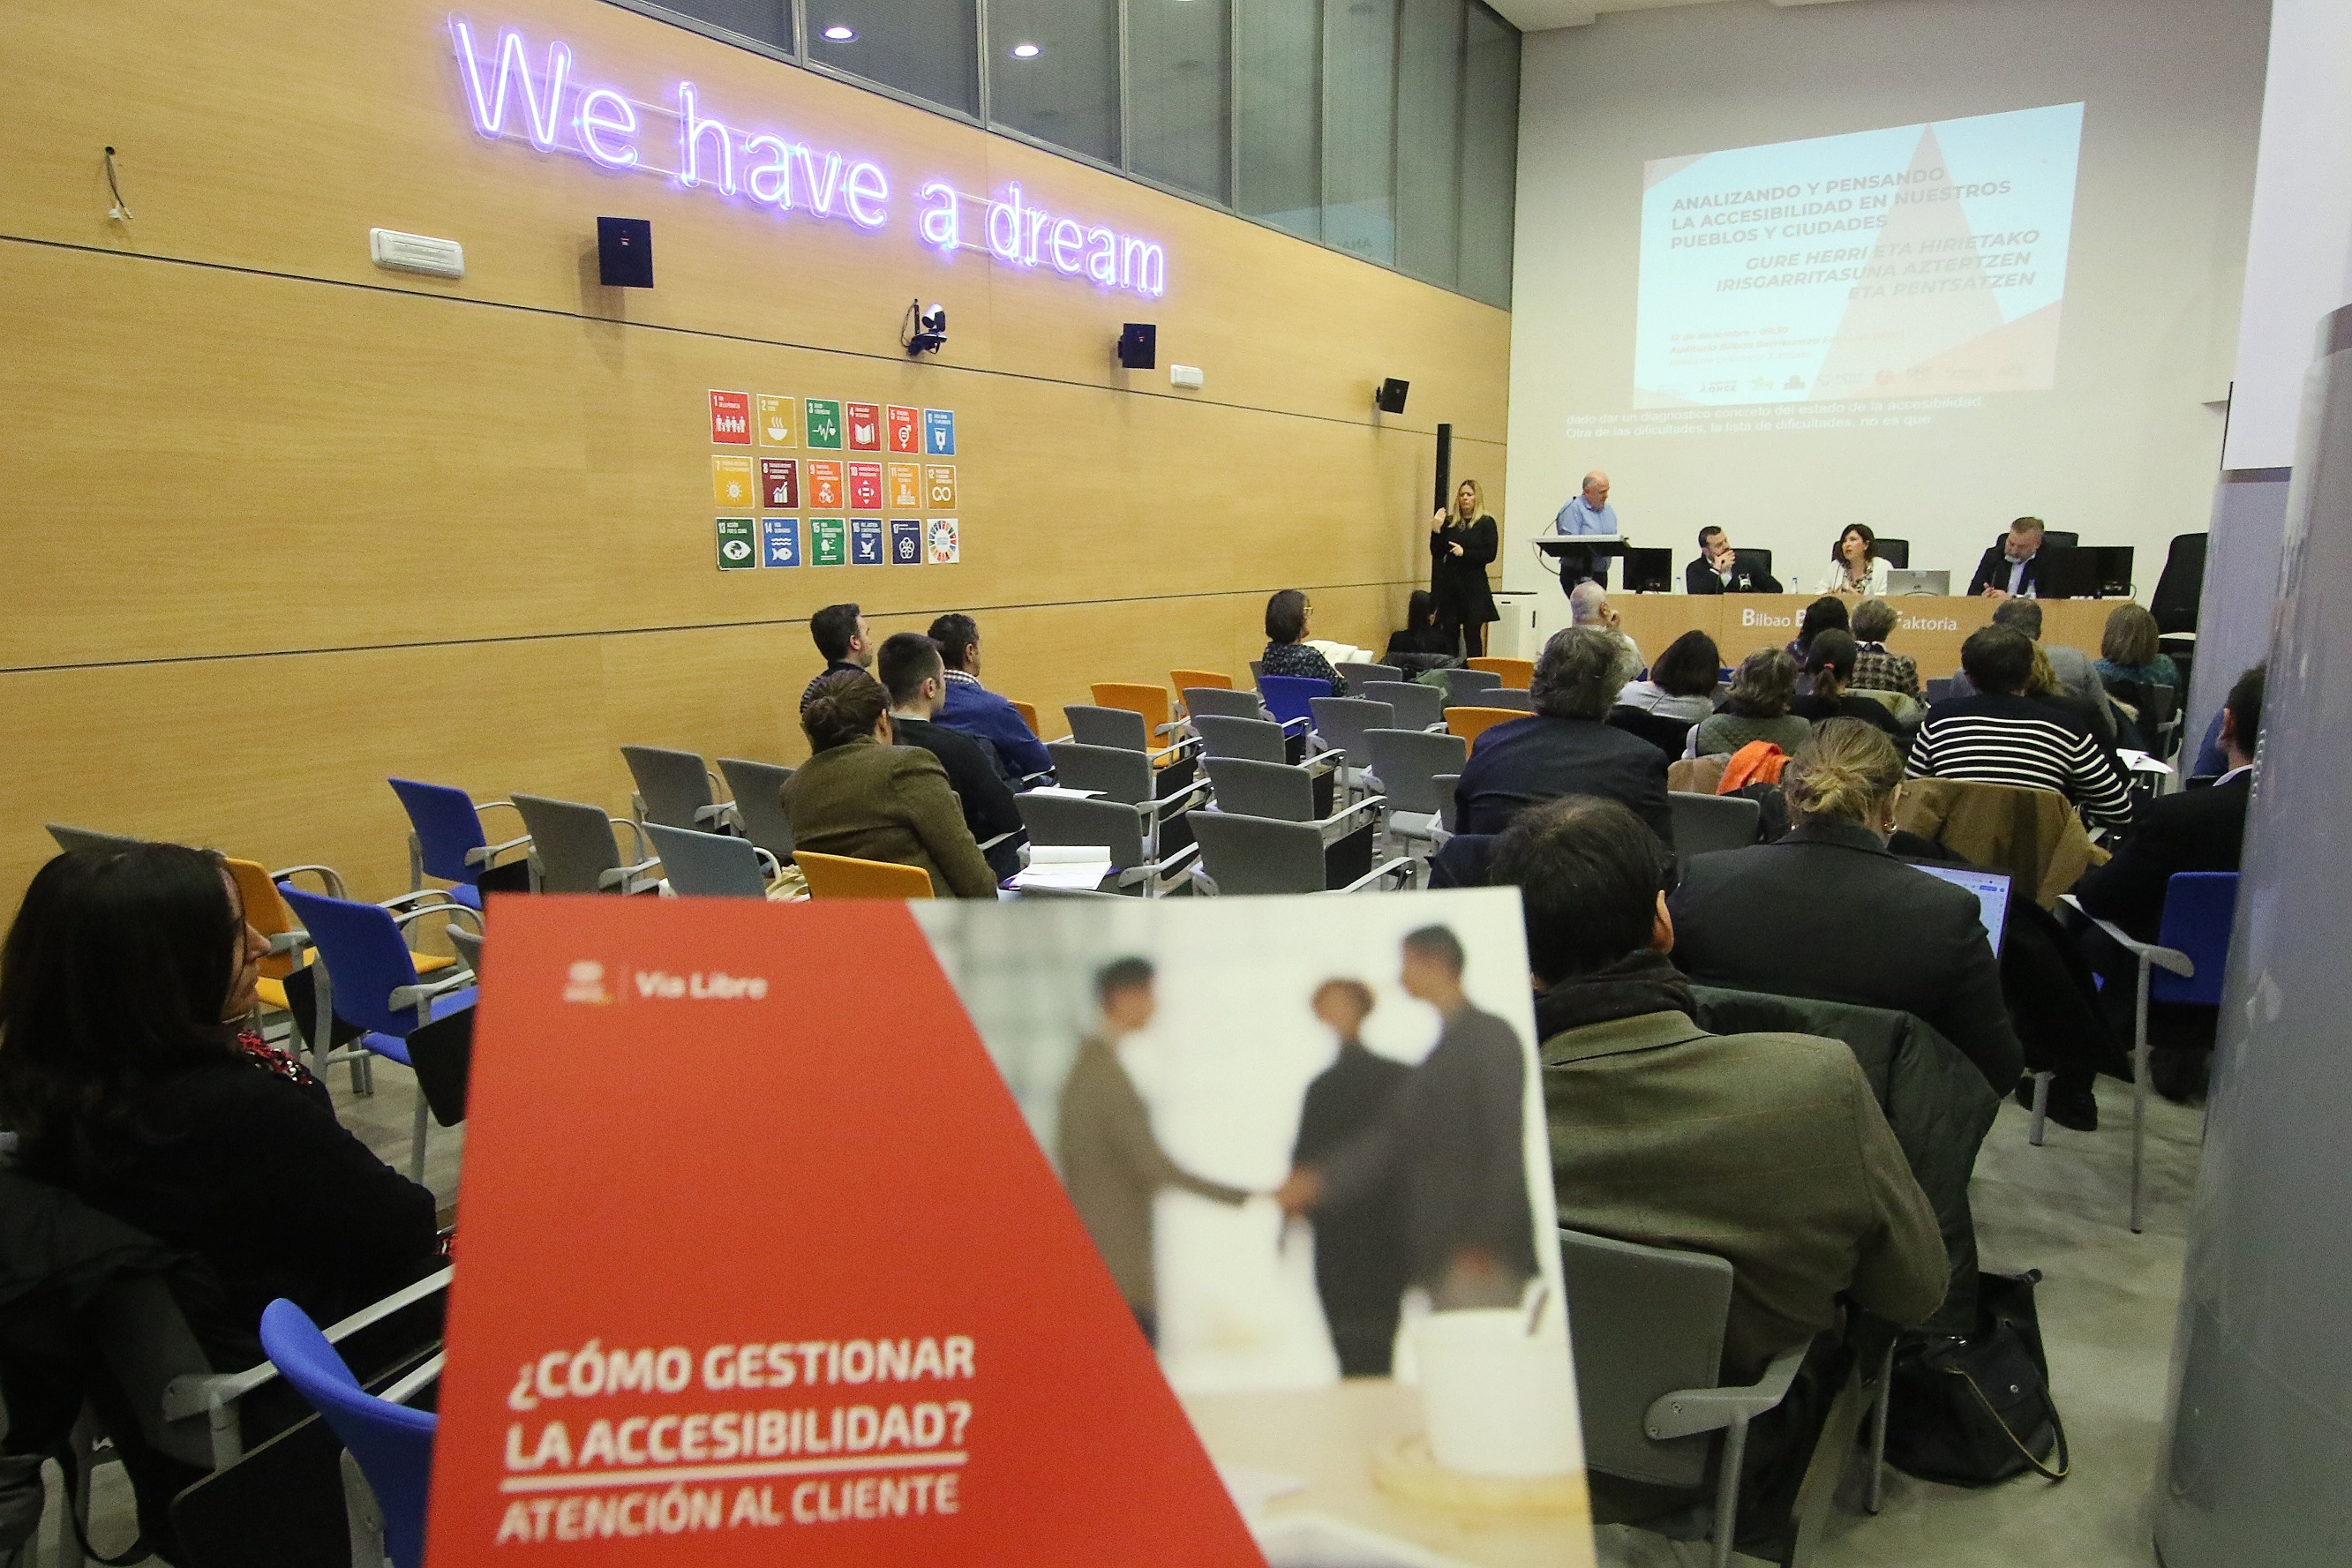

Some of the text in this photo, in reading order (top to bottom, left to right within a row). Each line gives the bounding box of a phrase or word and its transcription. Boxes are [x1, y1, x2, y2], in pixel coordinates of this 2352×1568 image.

[450, 16, 1165, 296] We have a dream
[1672, 167, 1944, 212] ANALIZANDO Y PENSANDO
[1672, 181, 2011, 230] LA ACCESIBILIDAD EN NUESTROS
[1671, 214, 1889, 249] PUEBLOS Y CIUDADES
[1745, 229, 2040, 271] GURE HERRI ETA HIRIETAKO
[1716, 251, 2032, 292] IRISGARRITASUNA AZTERTZEN
[1848, 271, 2035, 300] ETA PENTSATZEN
[1566, 428, 1592, 439] Otra
[1595, 427, 1610, 437] de
[1613, 427, 1630, 436] las
[1710, 423, 1722, 432] la
[1726, 421, 1751, 431] lista
[1755, 420, 1771, 431] de
[1860, 417, 1878, 426] no
[1904, 415, 1931, 427] que
[1567, 416, 1597, 425] dado
[1715, 408, 1770, 418] concreto
[1775, 406, 1793, 415] del
[1799, 403, 1845, 414] estado
[1849, 402, 1866, 412] de
[1742, 608, 1791, 627] Bilbao
[1897, 611, 1957, 631] aktoria
[635, 971, 686, 999] Via
[689, 970, 769, 1000] Libre
[507, 1334, 976, 1411] ¿CÓMO GESTIONAR
[505, 1399, 972, 1471] LA ACCESIBILIDAD?
[495, 1473, 959, 1545] ATENCIÓN AL CLIENTE
